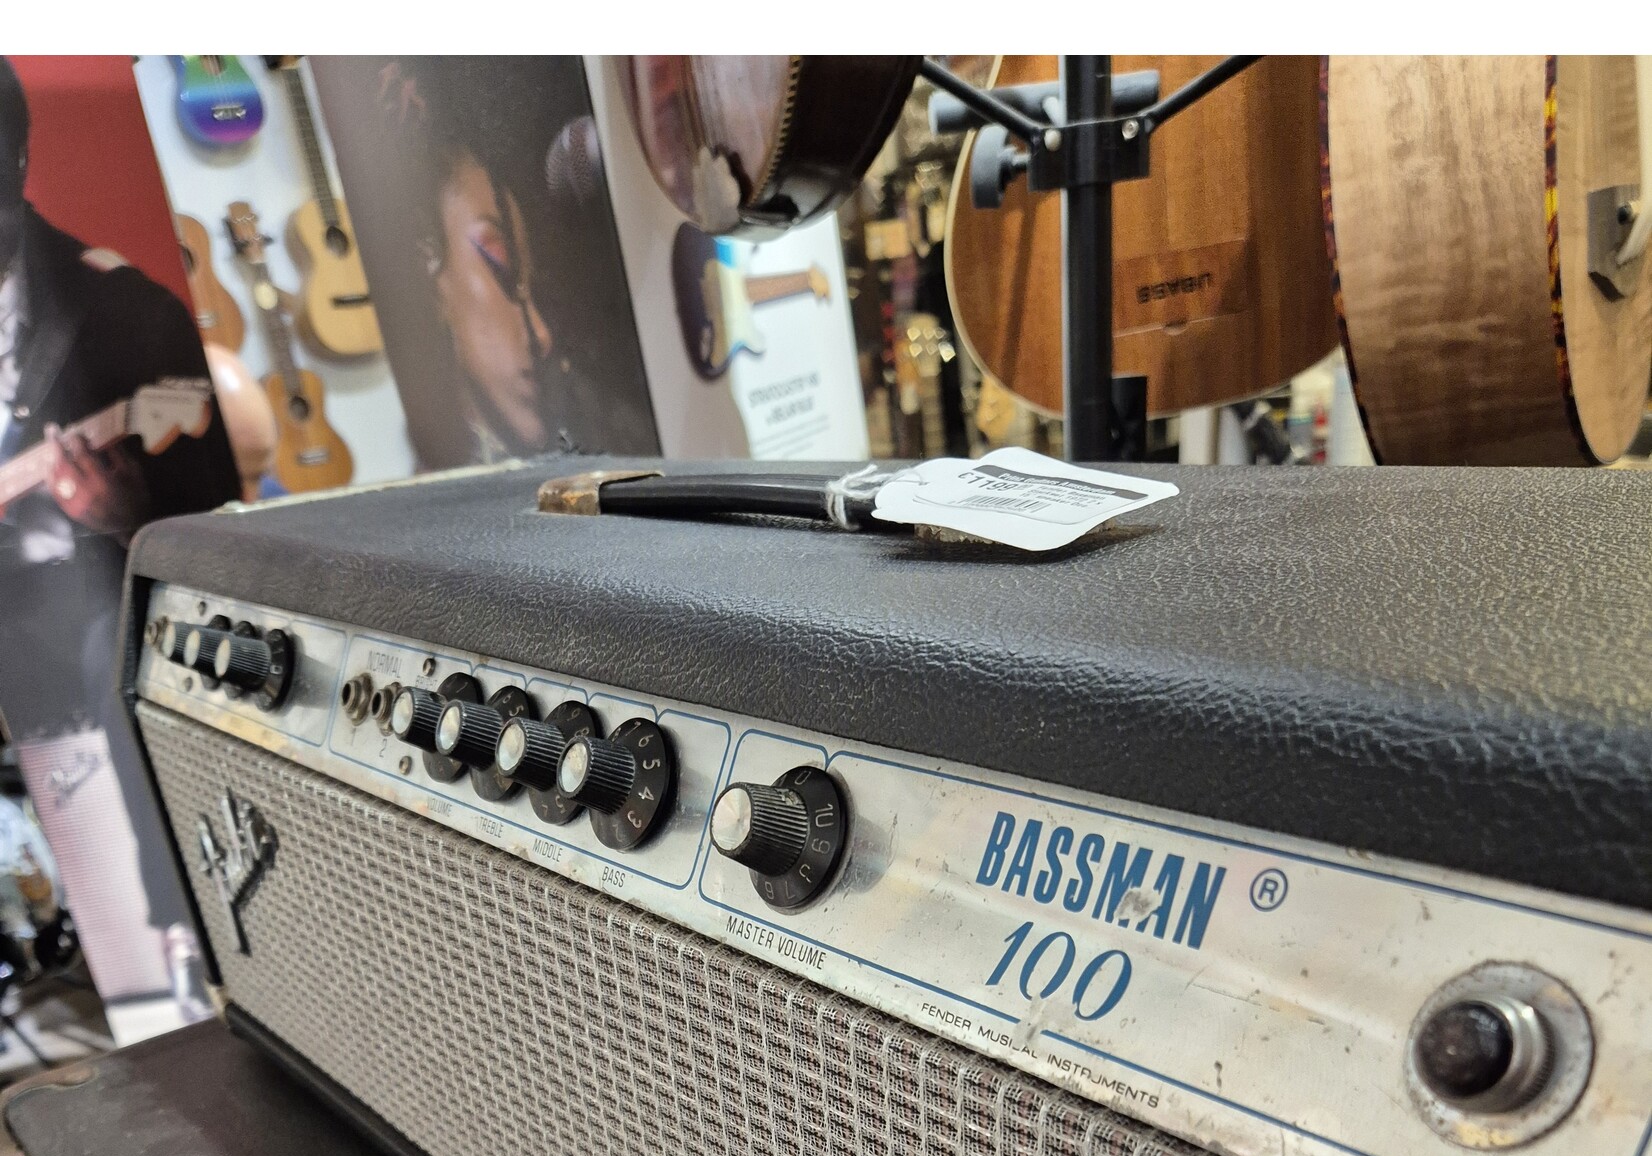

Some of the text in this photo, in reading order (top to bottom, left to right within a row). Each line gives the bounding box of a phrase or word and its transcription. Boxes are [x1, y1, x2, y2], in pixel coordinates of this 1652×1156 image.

[367, 650, 402, 678] NORMAL
[379, 738, 388, 758] 2
[638, 734, 655, 748] 6
[642, 758, 661, 770] 5
[638, 786, 655, 801] 4
[479, 815, 504, 838] TREBLE
[627, 810, 642, 829] 3
[532, 838, 563, 863] MIDDLE
[601, 865, 626, 888] BASS
[975, 810, 1228, 951] BASSMAN
[725, 915, 827, 971] MASTER VOLUME
[984, 920, 1133, 1022] 100
[920, 1002, 1160, 1109] FENDER MUSIAL INSTRUMENTS
